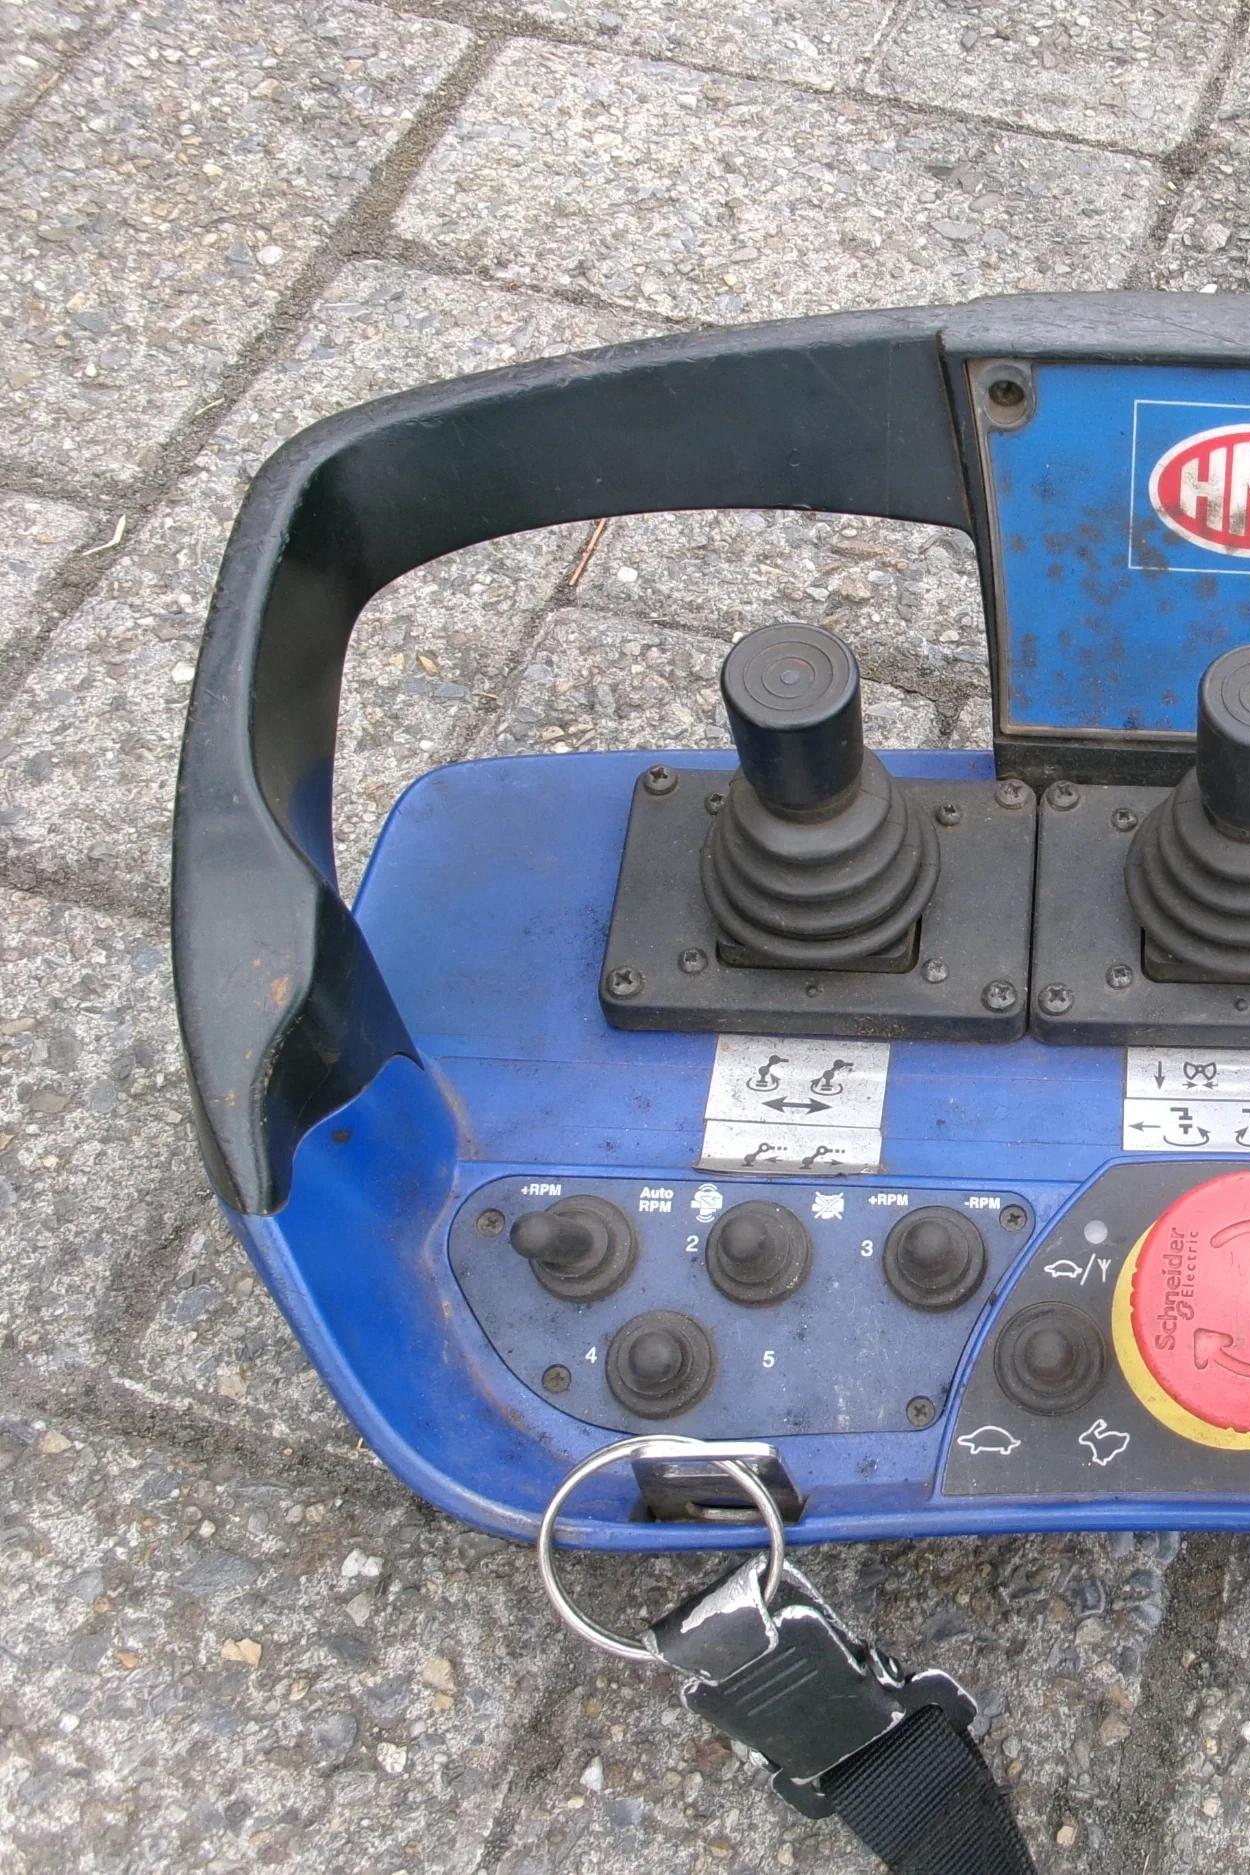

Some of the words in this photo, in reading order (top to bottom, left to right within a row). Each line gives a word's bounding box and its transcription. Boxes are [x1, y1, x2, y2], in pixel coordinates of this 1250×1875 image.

[521, 1184, 562, 1196] +RPM
[640, 1187, 674, 1199] Auto
[638, 1200, 672, 1213] RPM
[868, 1194, 909, 1206] +RPM
[964, 1197, 1001, 1209] -RPM
[685, 1235, 699, 1252] 2
[860, 1240, 874, 1257] 3
[1181, 1230, 1199, 1298] Electric
[1154, 1227, 1185, 1351] Schneider
[585, 1347, 598, 1363] 4
[762, 1351, 775, 1368] 5
